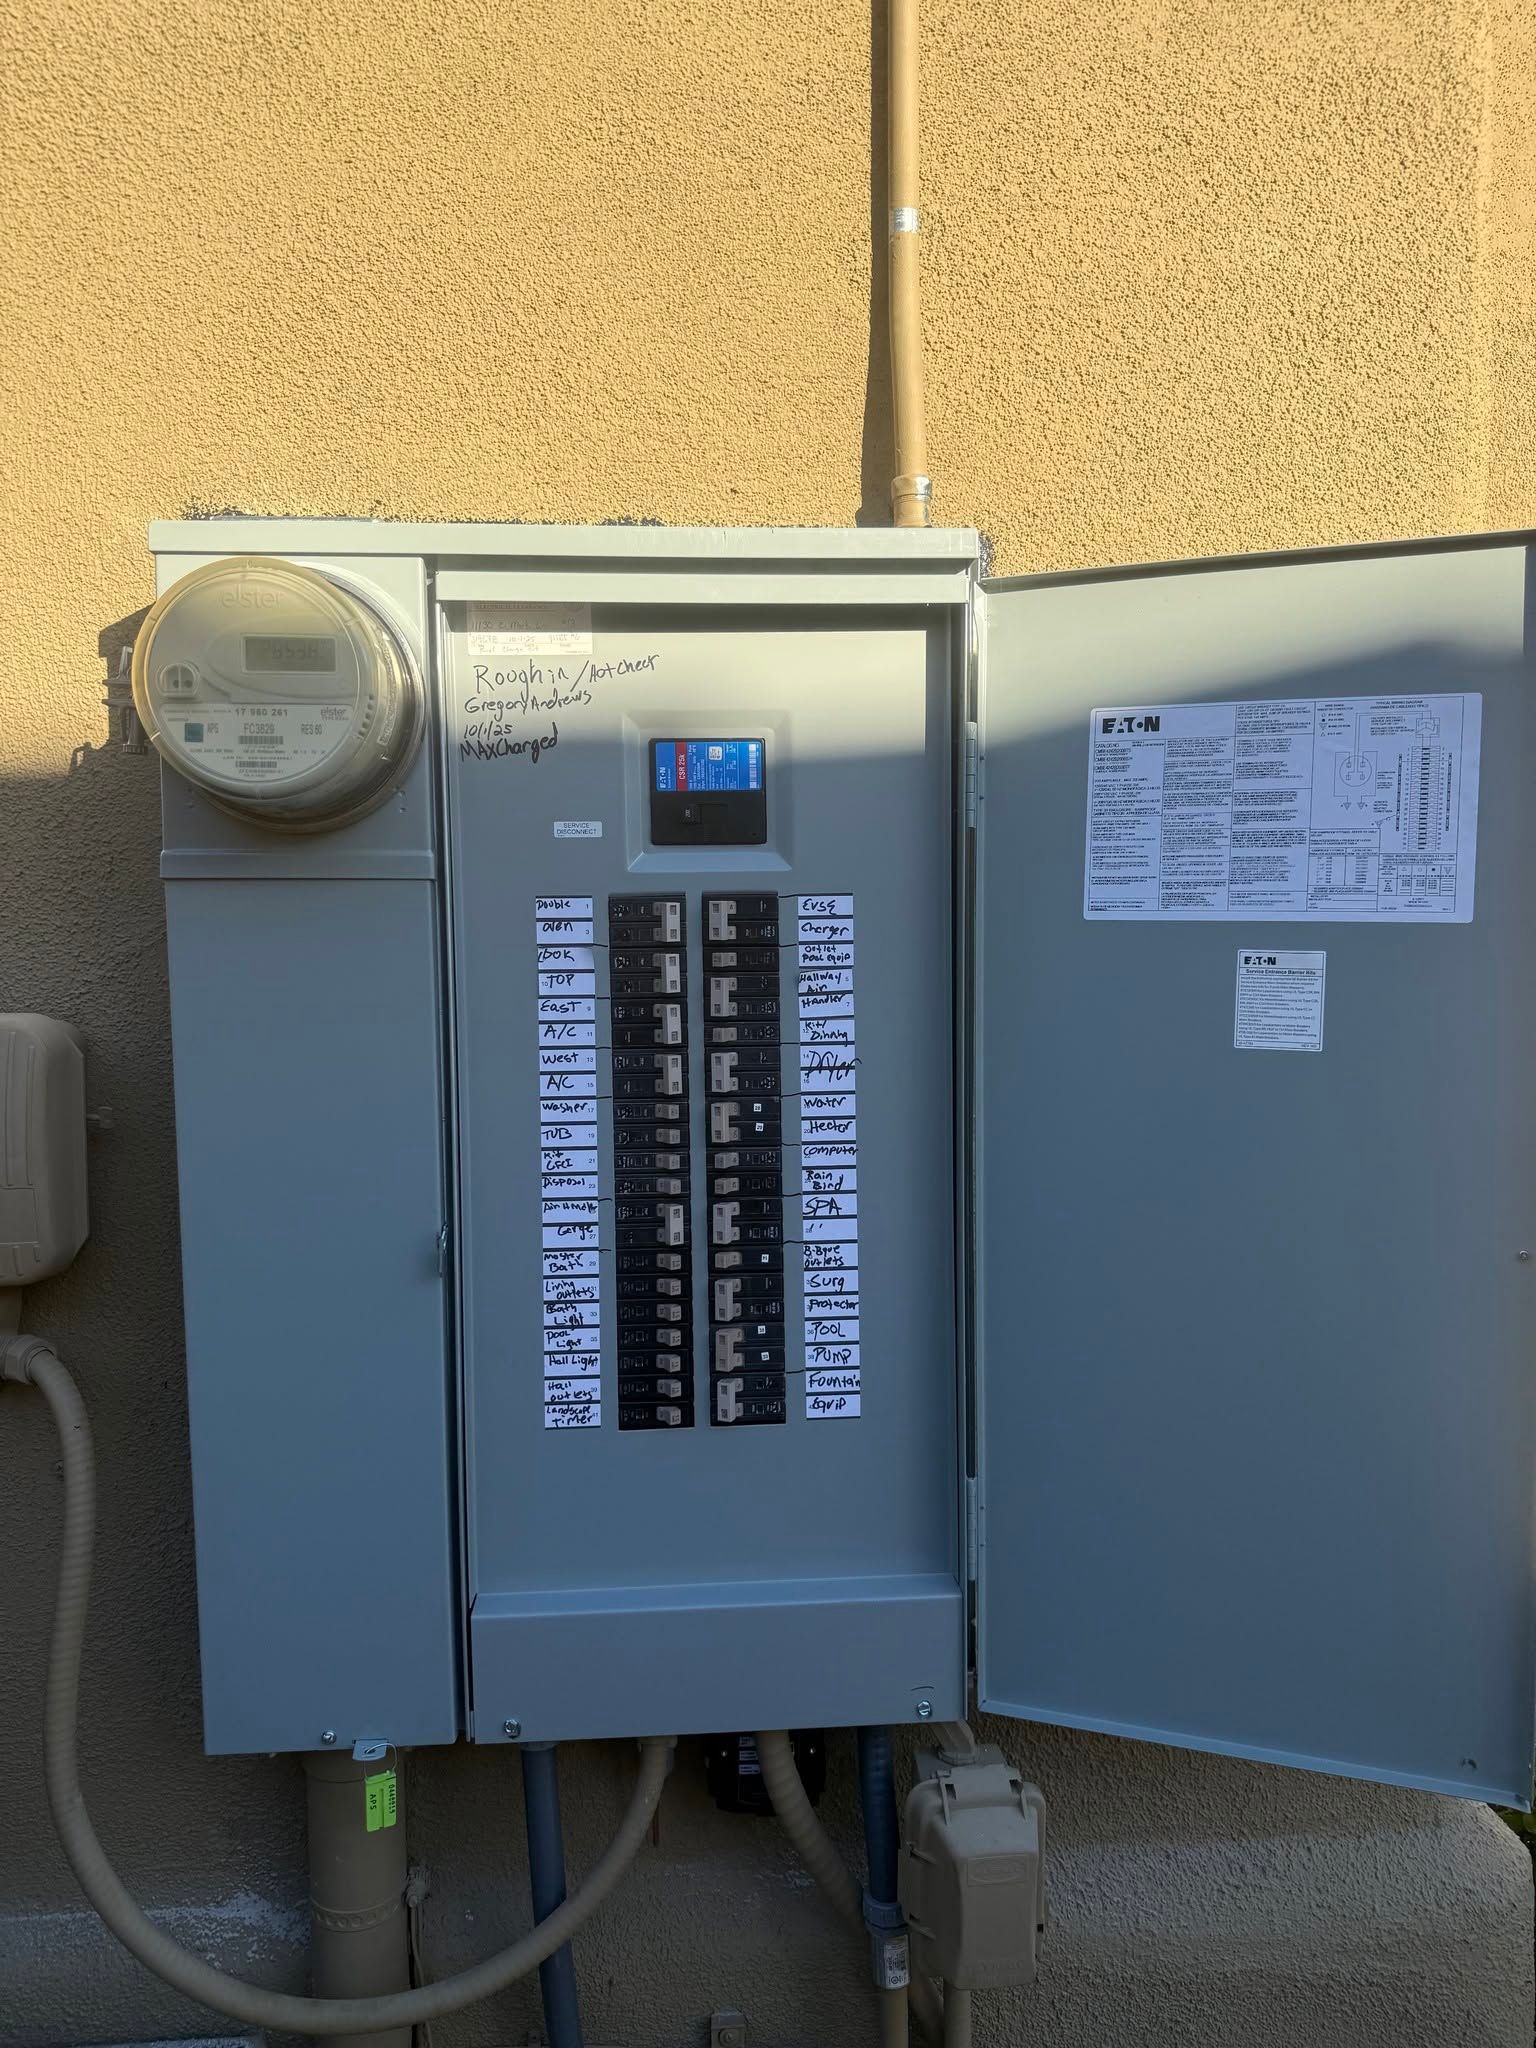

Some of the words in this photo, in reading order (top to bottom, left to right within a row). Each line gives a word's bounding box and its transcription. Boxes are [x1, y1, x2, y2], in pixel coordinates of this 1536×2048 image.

[473, 658, 543, 697] Rough
[464, 690, 528, 721] Gregory
[531, 688, 592, 712] Andrews
[1102, 715, 1160, 734] EATON
[1244, 956, 1276, 965] EATON
[544, 1023, 577, 1039] A/C
[547, 1074, 575, 1091] A/C
[802, 1197, 842, 1216] SPA
